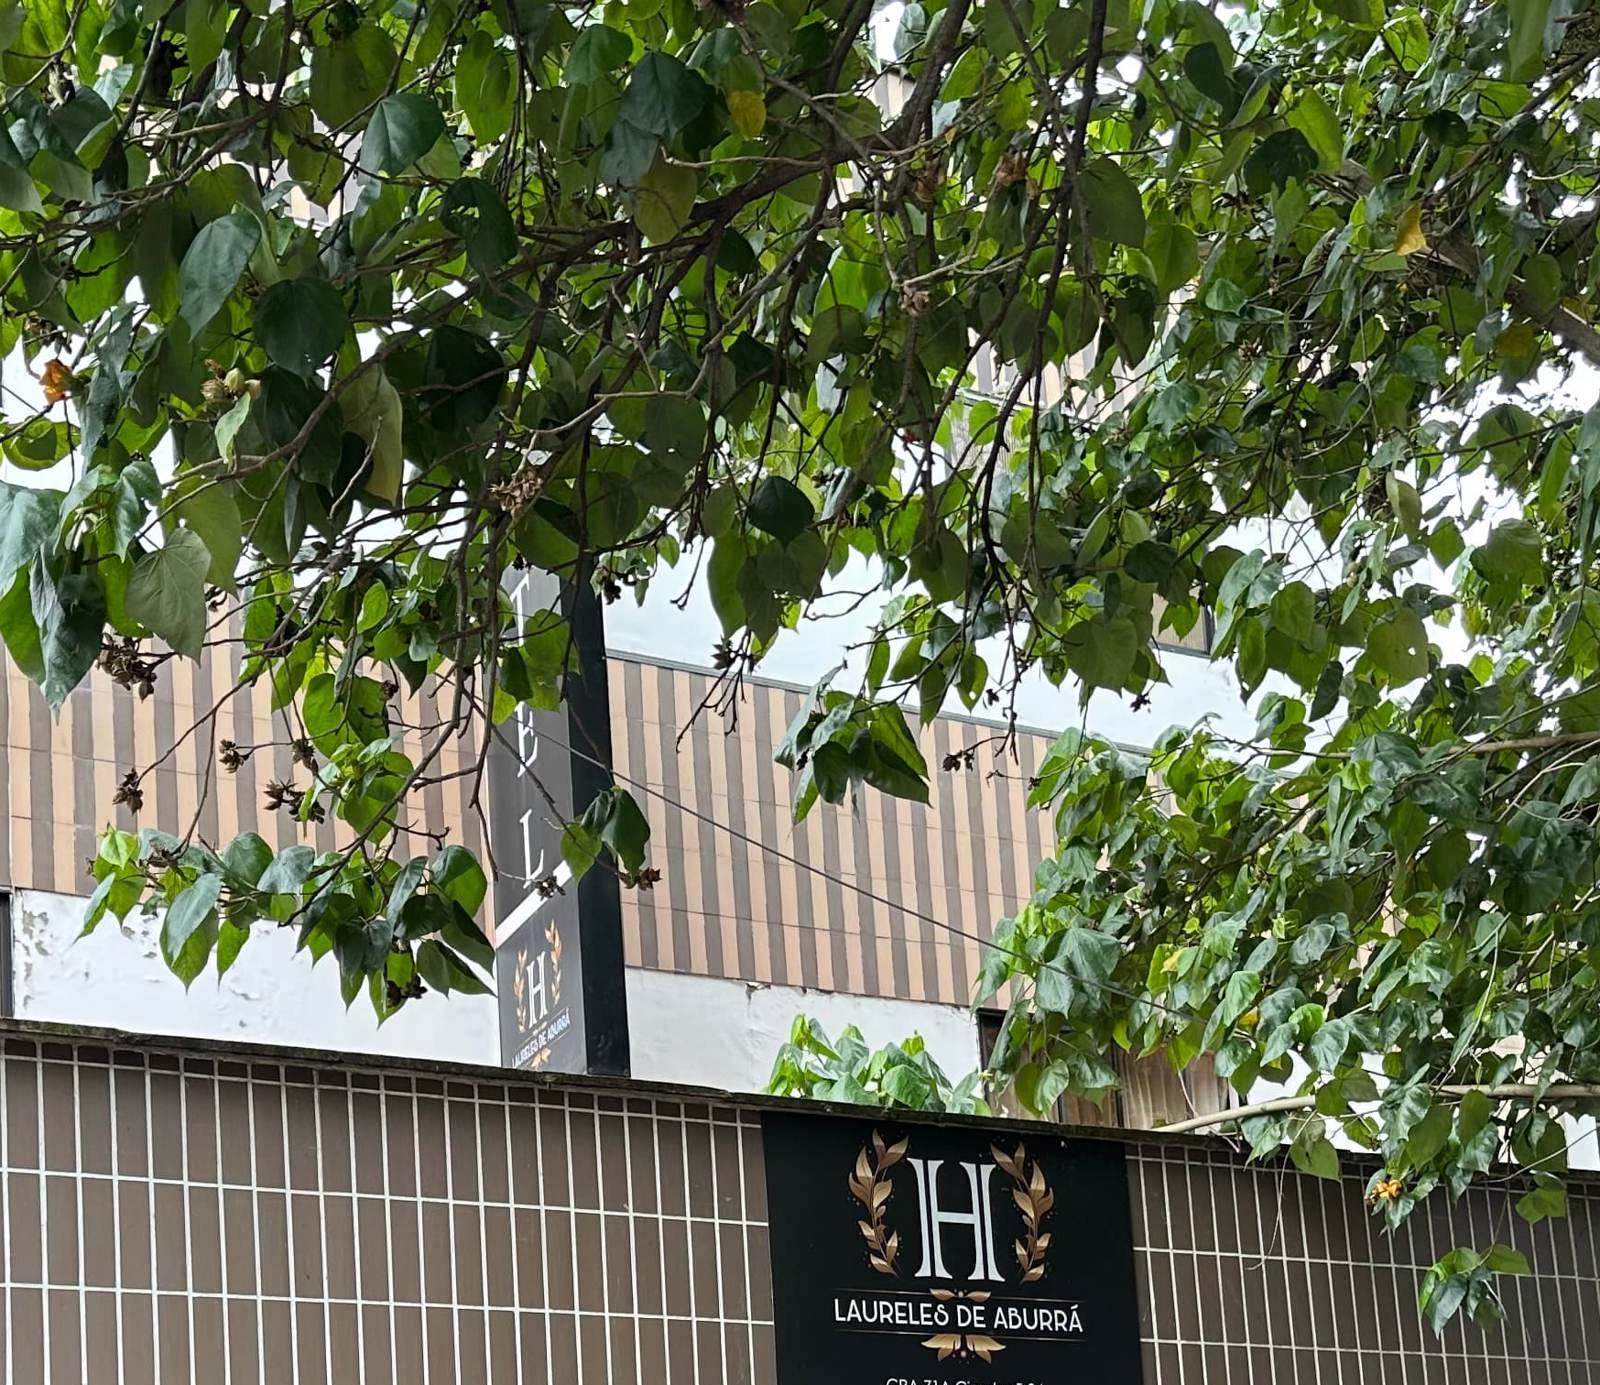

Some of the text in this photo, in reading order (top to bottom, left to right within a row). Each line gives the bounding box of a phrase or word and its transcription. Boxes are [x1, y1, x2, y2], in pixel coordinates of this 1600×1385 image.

[526, 949, 547, 1027] H
[906, 1157, 1006, 1282] H
[834, 1297, 1083, 1333] LAURELES DE ABURRÁ
